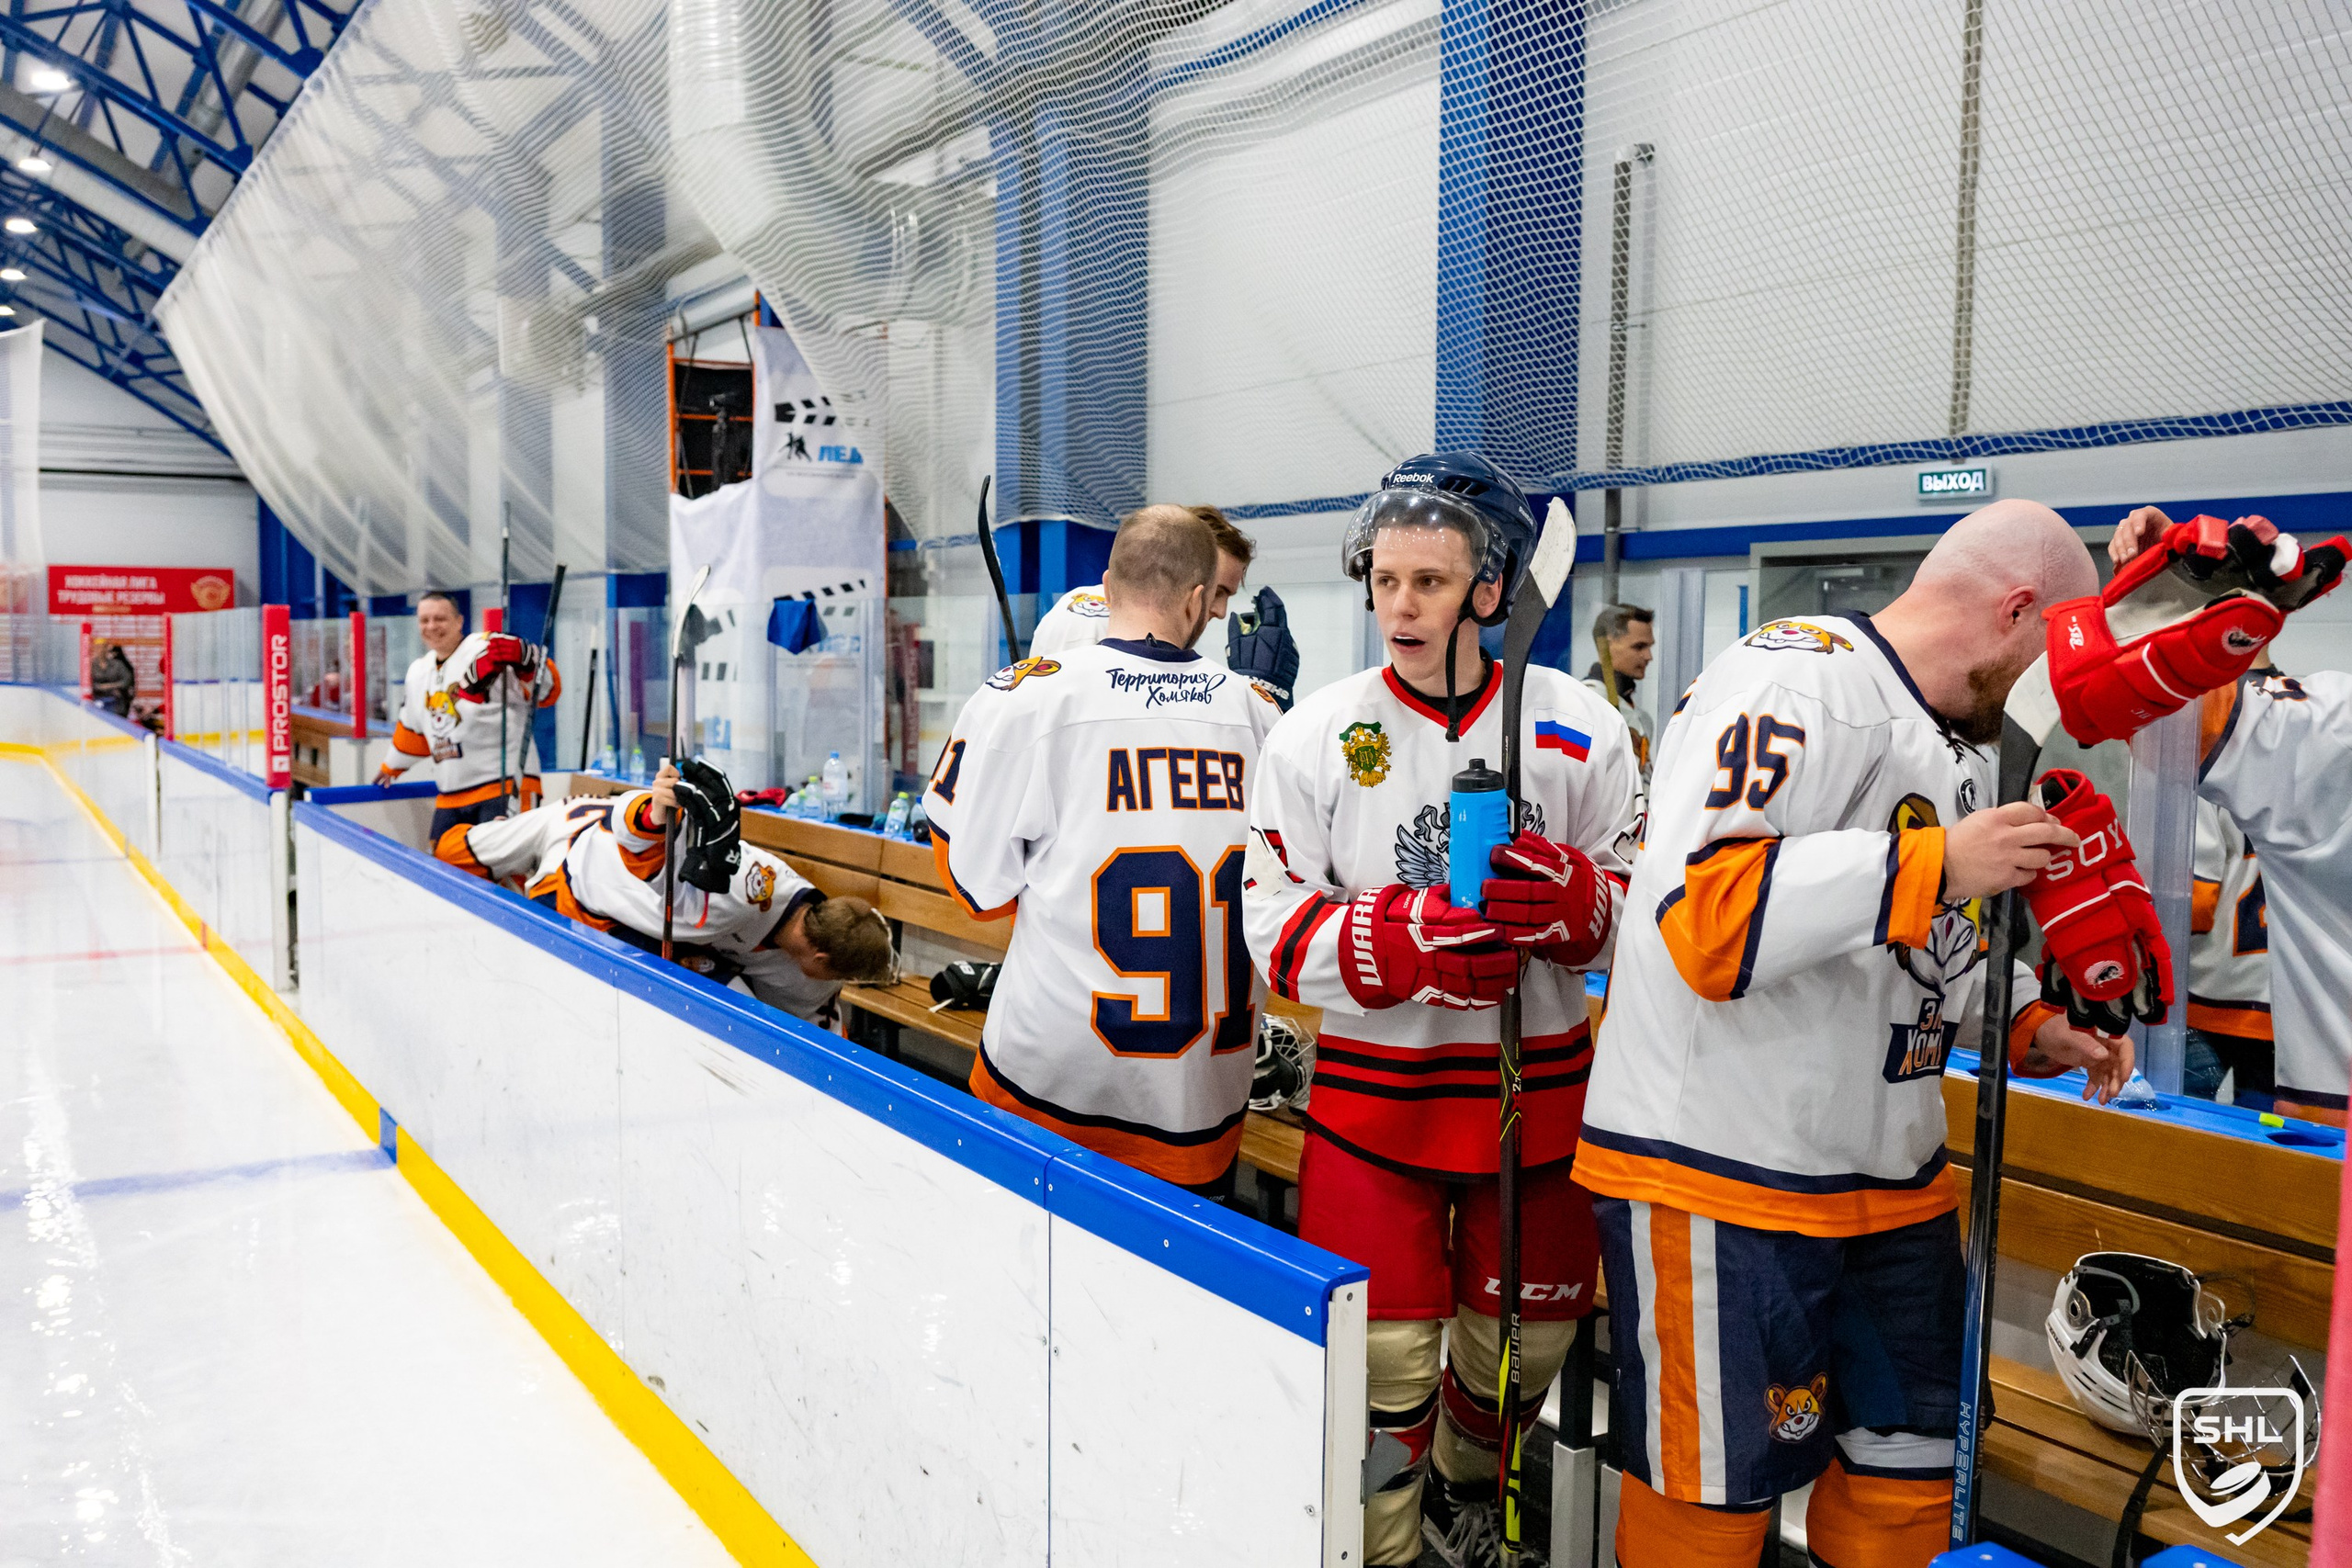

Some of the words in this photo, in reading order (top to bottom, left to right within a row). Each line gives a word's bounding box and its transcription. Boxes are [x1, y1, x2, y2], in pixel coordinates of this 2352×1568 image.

[1393, 472, 1435, 484] Reebok
[1922, 471, 1984, 491] ВЫХОД
[271, 634, 288, 752] PROSTOR
[1105, 668, 1208, 692] Территория
[1146, 673, 1227, 709] Хомяков
[929, 734, 966, 807] 1
[1106, 747, 1245, 812] АГЕЕВ
[1704, 712, 1806, 811] 95
[1403, 893, 1413, 908] COVERT
[1091, 844, 1256, 1059] 91
[1351, 885, 1384, 987] WARR
[1484, 1276, 1583, 1301] CCM
